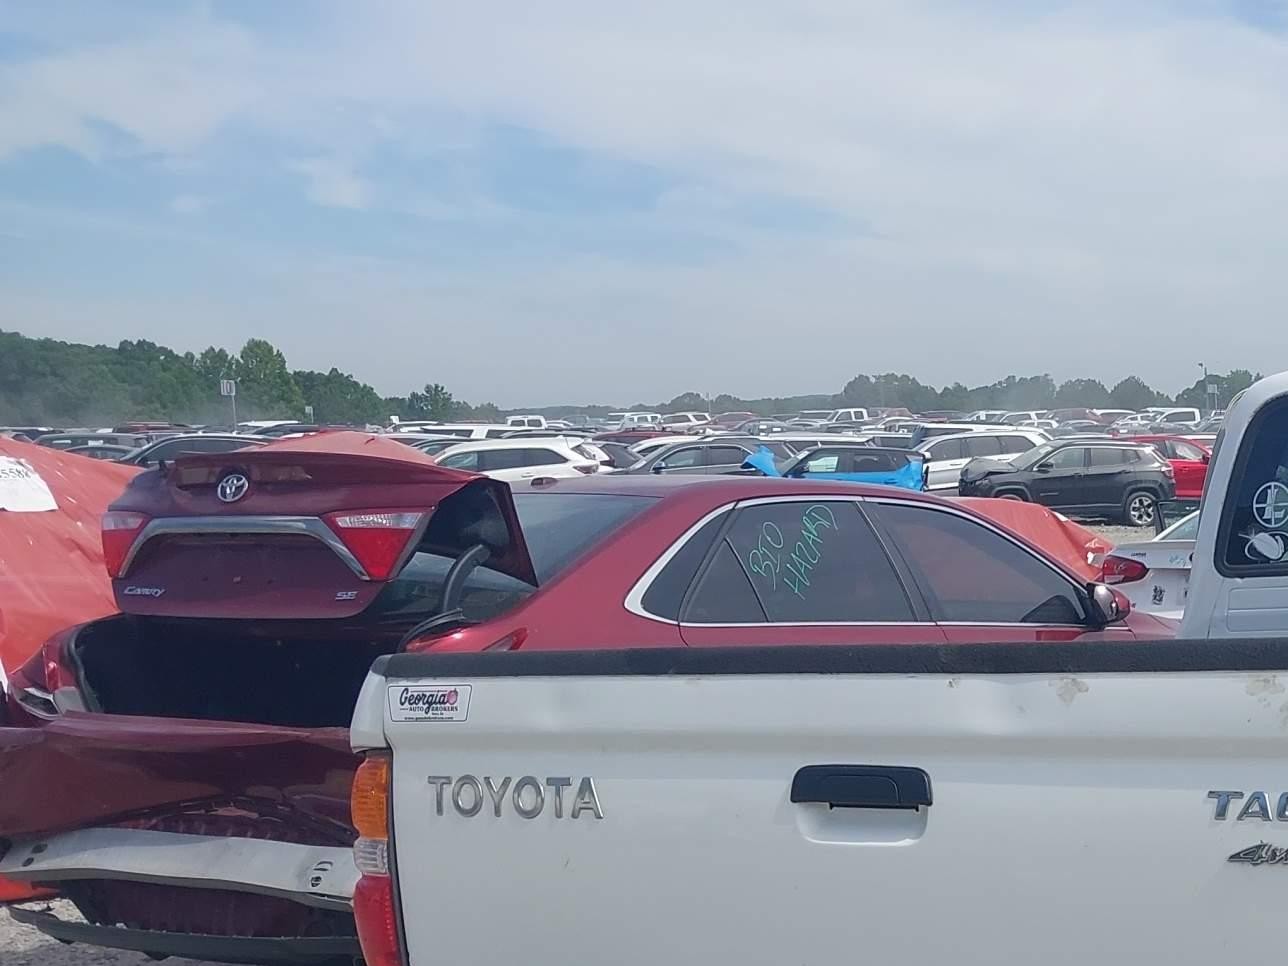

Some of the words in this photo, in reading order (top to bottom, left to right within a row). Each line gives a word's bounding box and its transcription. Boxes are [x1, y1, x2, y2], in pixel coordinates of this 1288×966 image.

[749, 521, 784, 592] BIO
[783, 504, 838, 600] HAZARD
[124, 585, 166, 597] Camry
[335, 591, 359, 600] SE
[399, 687, 449, 714] Georgia
[427, 775, 604, 820] TOYOTA
